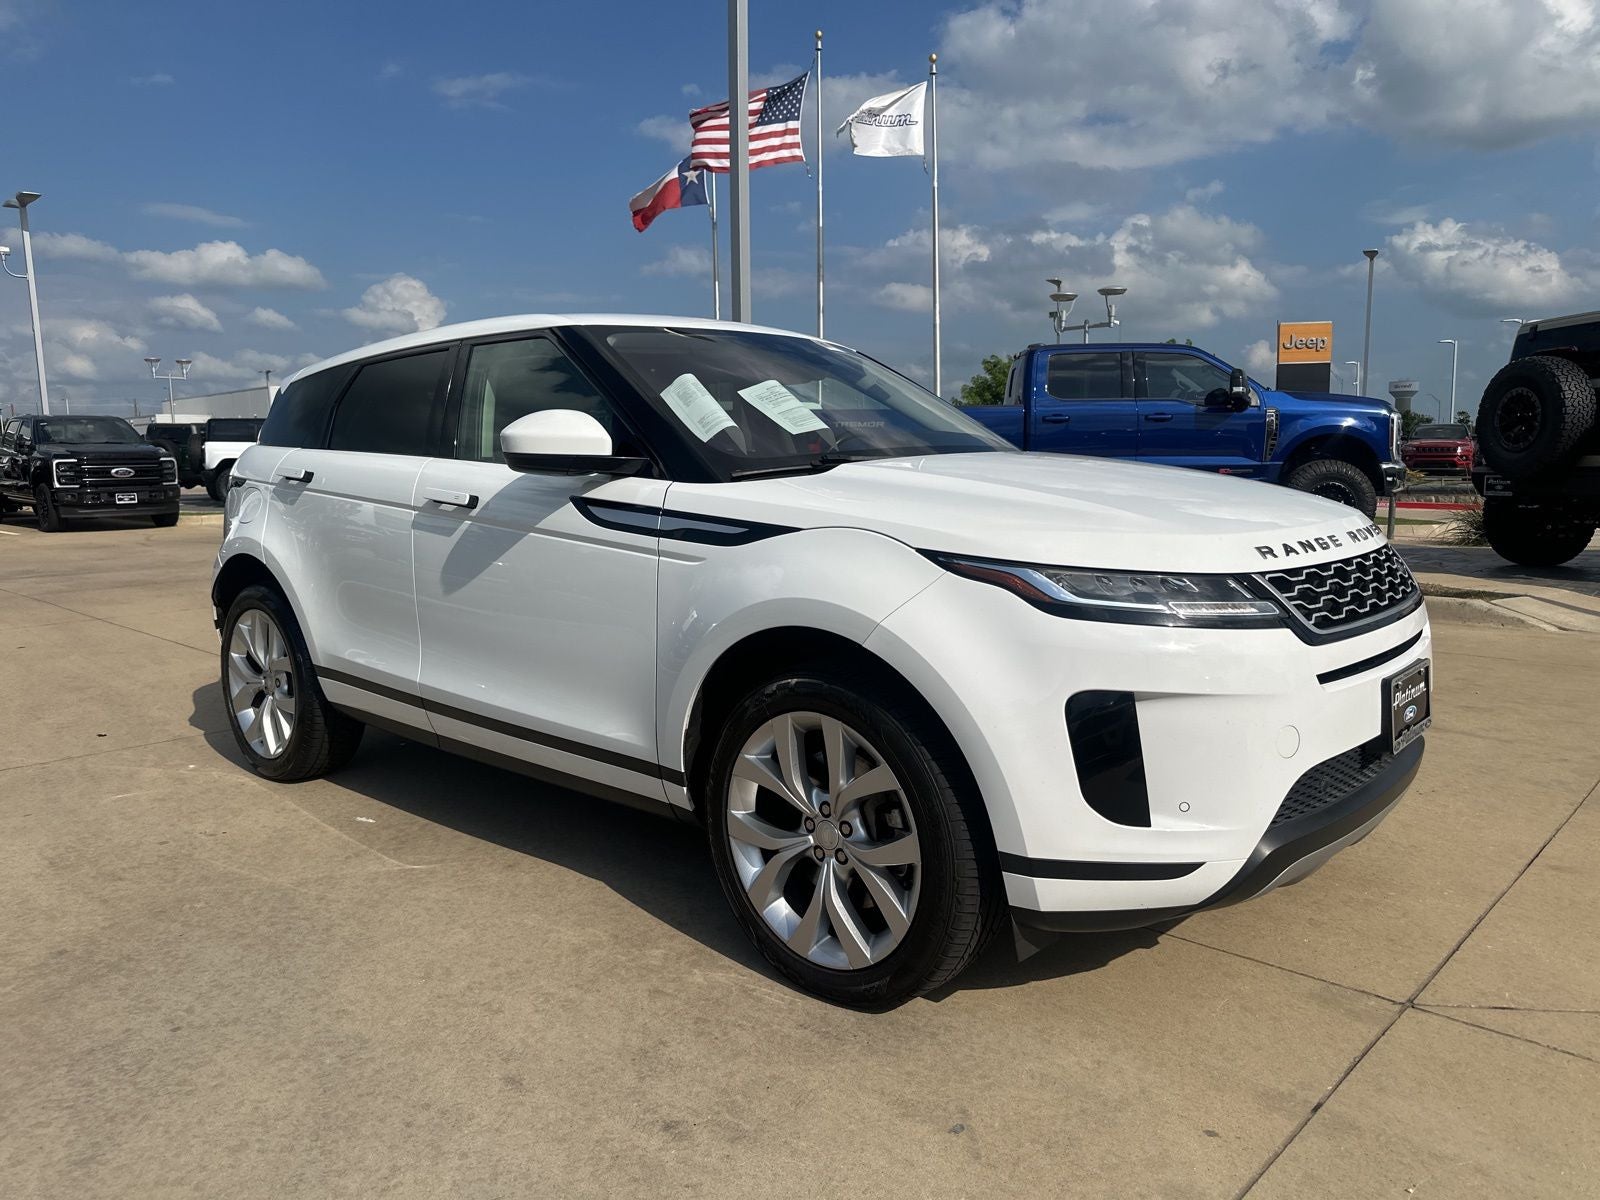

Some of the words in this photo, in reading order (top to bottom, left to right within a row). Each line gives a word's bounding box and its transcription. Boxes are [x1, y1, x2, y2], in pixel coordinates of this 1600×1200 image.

[1282, 332, 1328, 352] Jeep
[1254, 535, 1342, 559] RANGE
[1346, 523, 1383, 543] ROVE
[1393, 681, 1427, 710] Platinum
